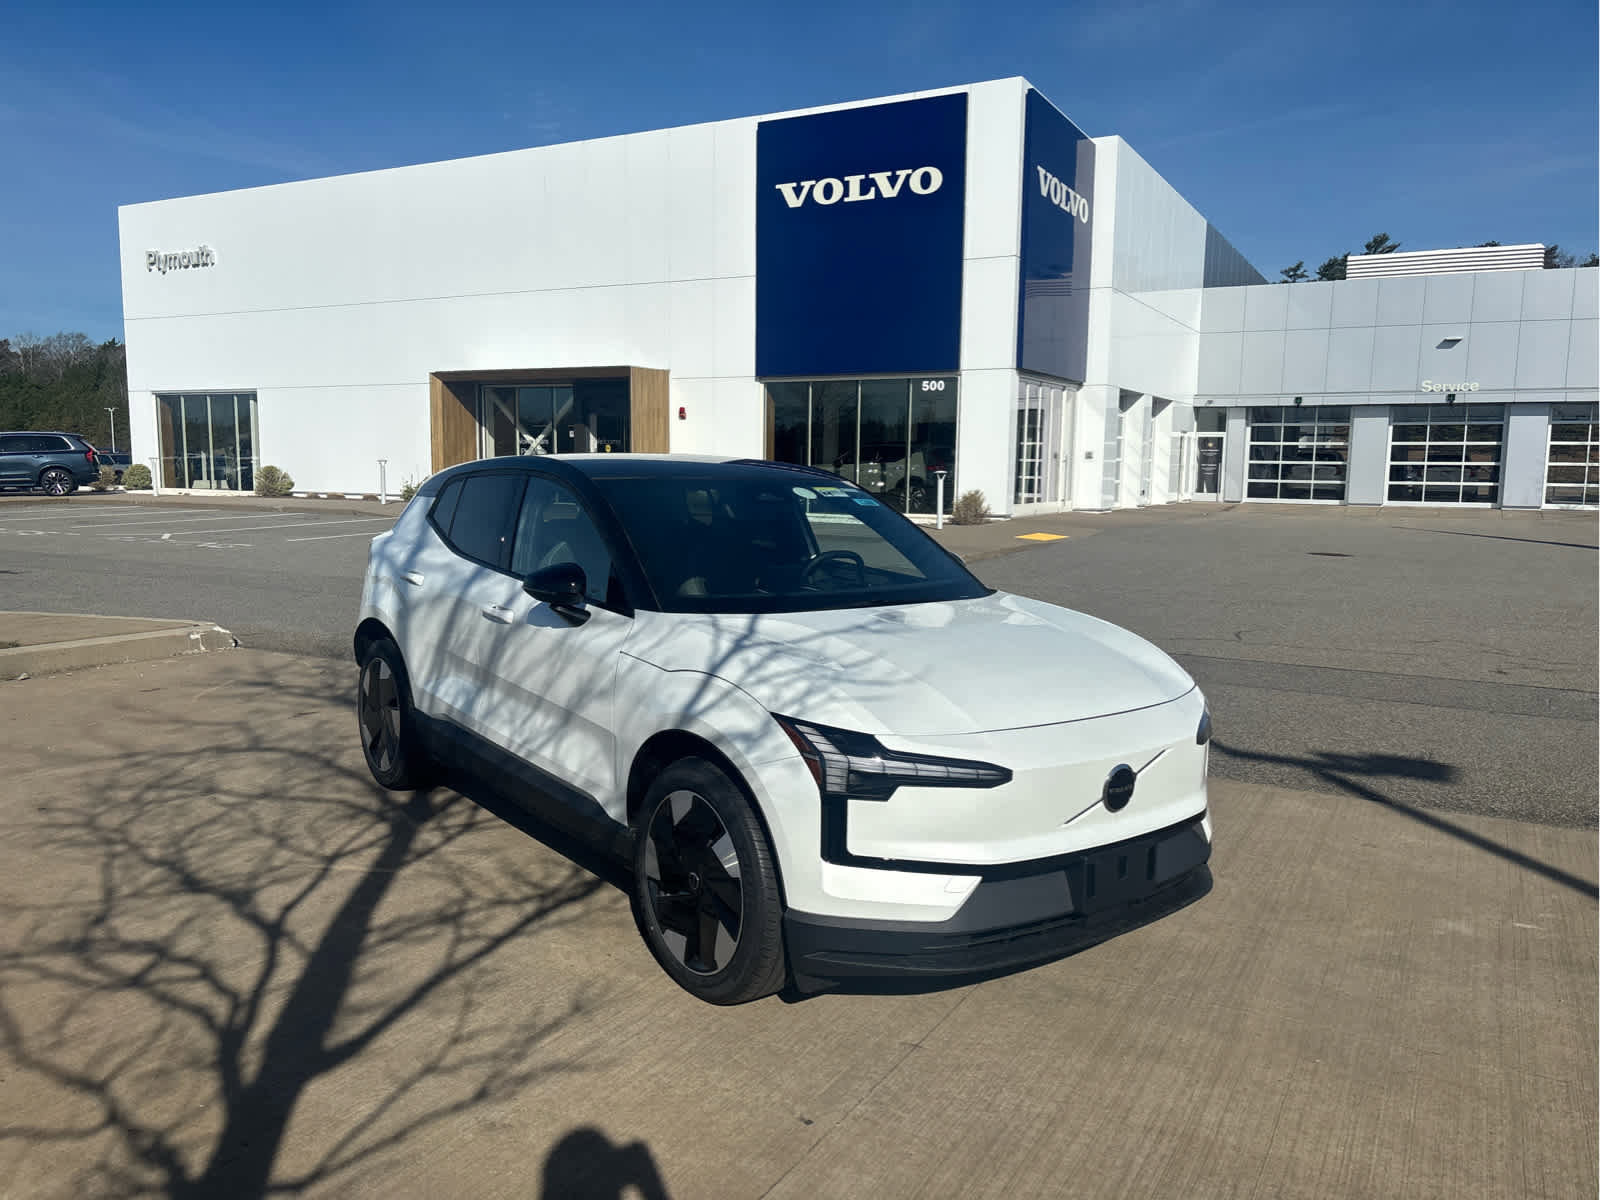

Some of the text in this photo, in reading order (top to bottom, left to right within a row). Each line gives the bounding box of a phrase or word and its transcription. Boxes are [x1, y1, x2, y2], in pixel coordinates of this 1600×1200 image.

[775, 166, 943, 208] VOLVO
[1036, 165, 1089, 224] VOLVO
[145, 245, 215, 275] Plymouth
[921, 380, 945, 391] 500
[1421, 379, 1480, 393] Service
